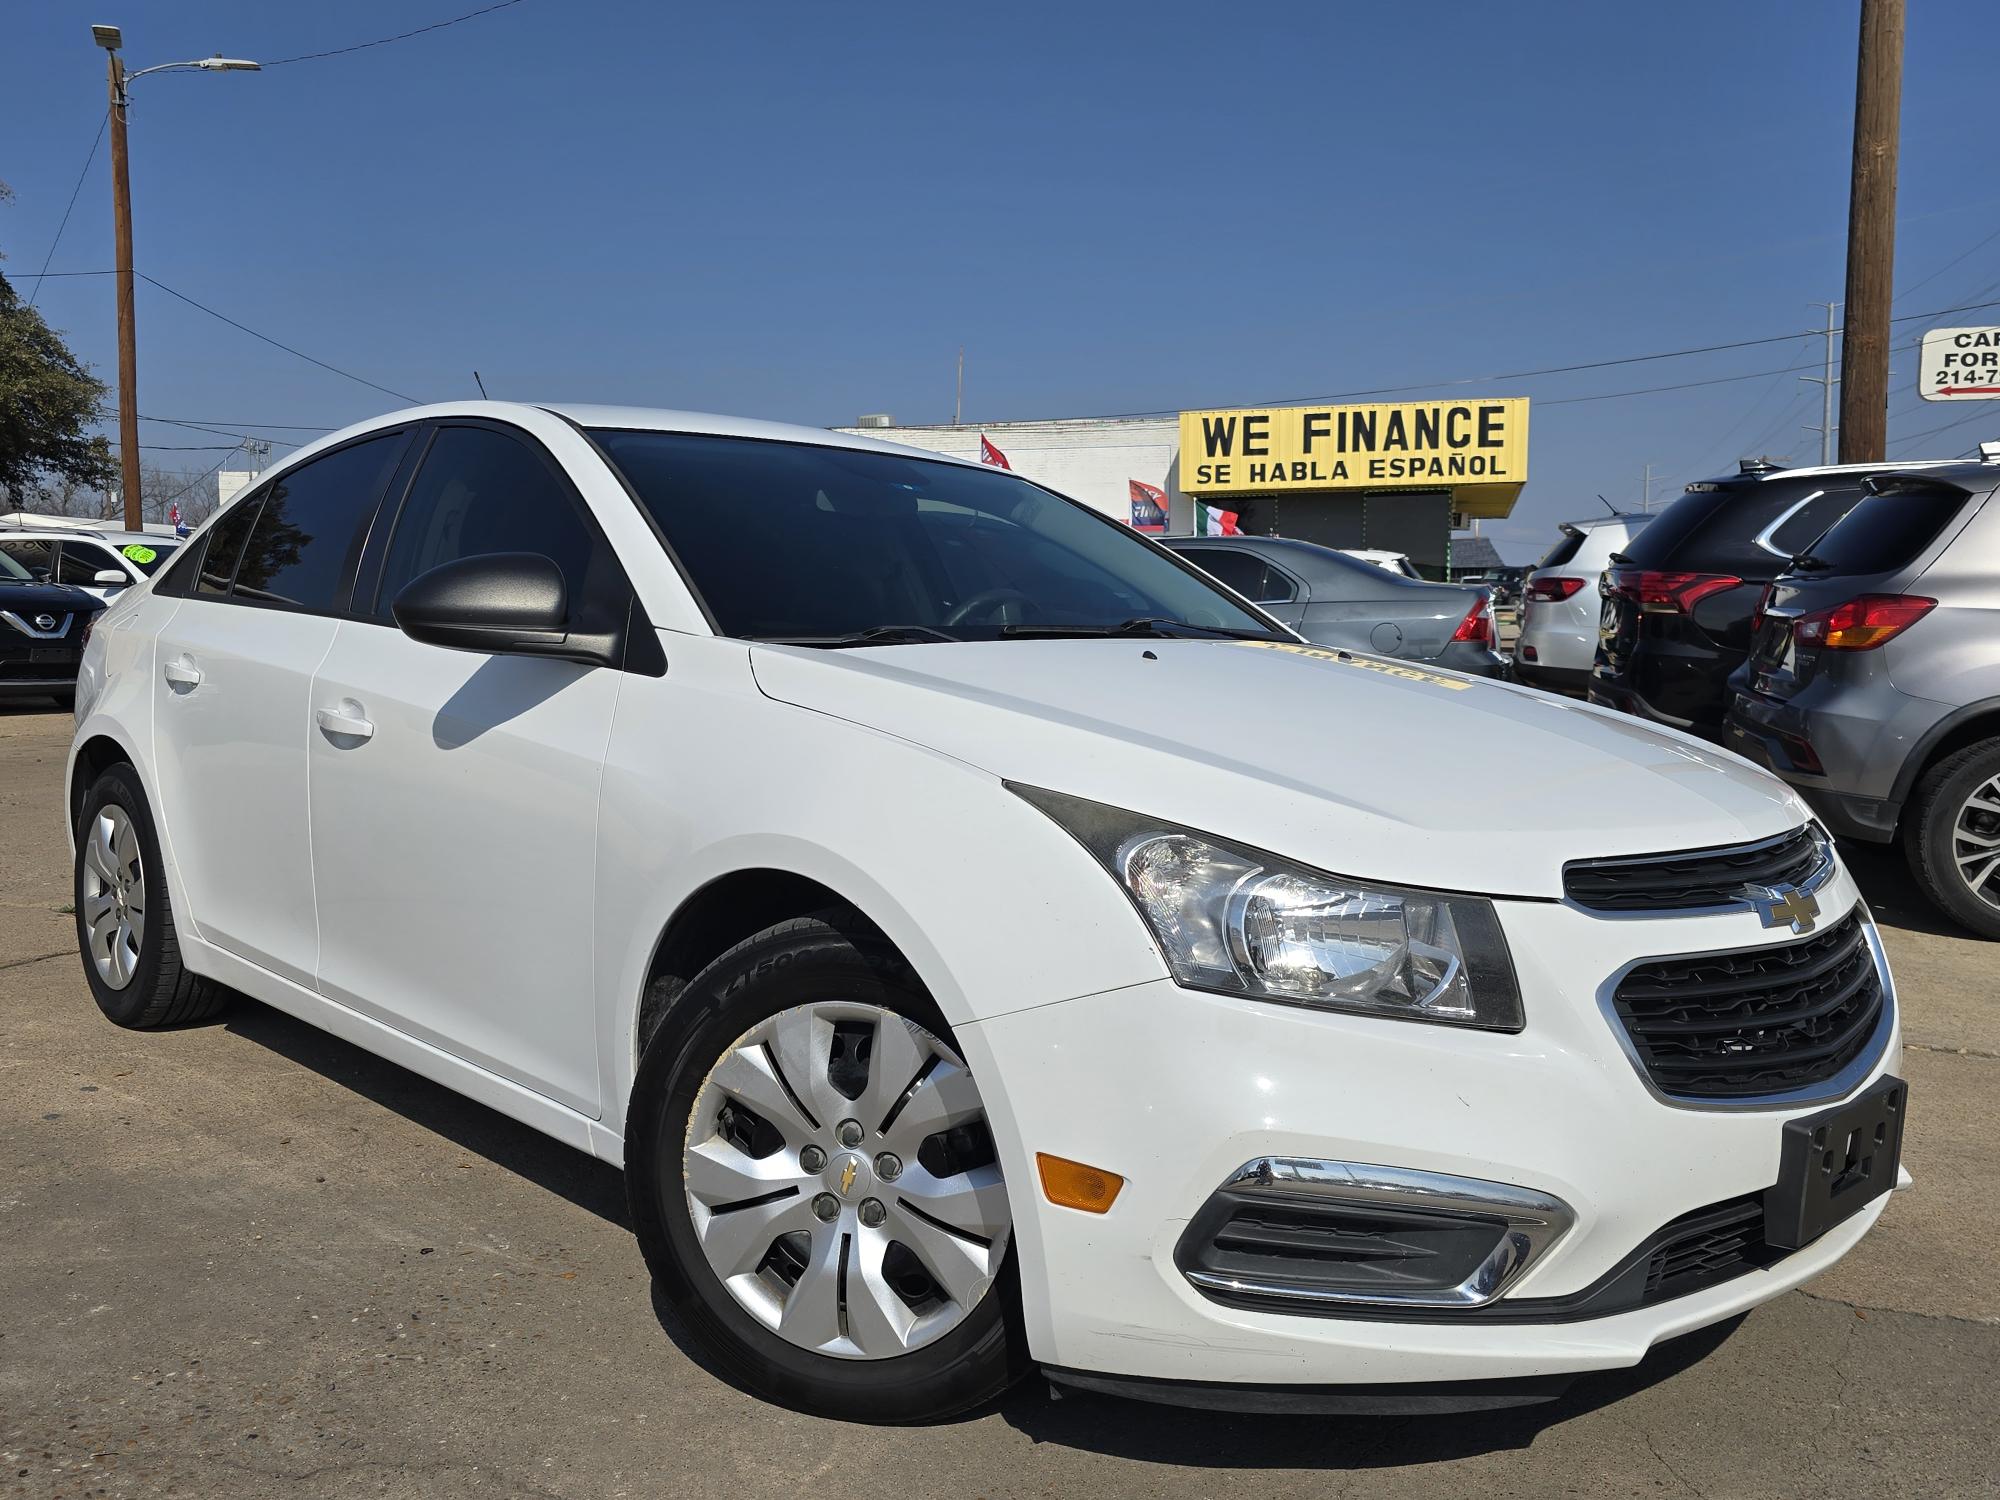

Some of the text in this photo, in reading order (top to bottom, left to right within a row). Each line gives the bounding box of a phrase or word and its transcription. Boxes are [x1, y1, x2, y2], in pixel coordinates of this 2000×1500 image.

[1944, 353, 1998, 367] FOR
[1936, 370, 2000, 384] 214-7
[1202, 406, 1505, 457] WE FINANCE
[1197, 453, 1507, 484] SE HABLA ESPAÑOL
